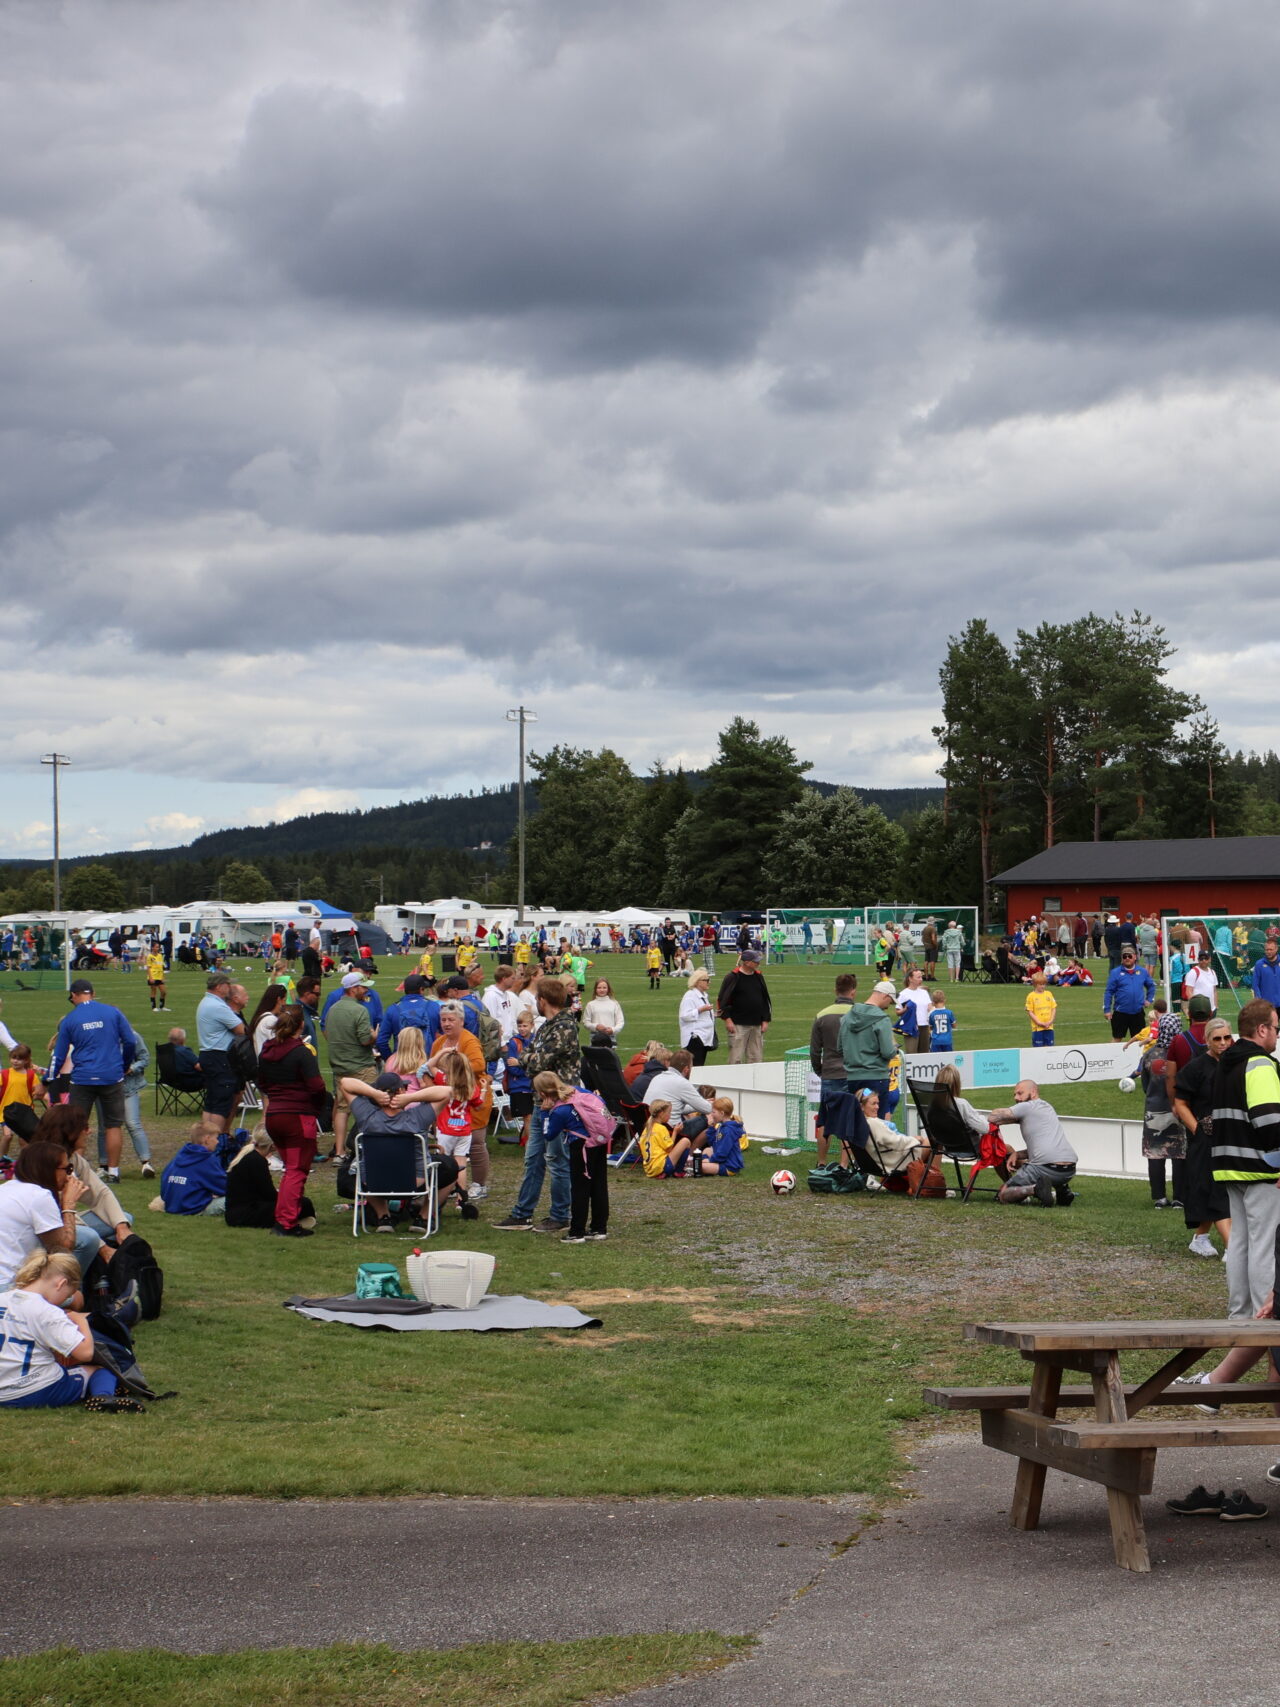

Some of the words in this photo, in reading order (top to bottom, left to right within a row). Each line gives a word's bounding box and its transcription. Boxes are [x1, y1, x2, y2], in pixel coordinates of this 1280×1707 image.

[1189, 945, 1196, 961] 4
[935, 1020, 948, 1034] 16
[1046, 1060, 1083, 1071] GLOBALL
[1087, 1059, 1115, 1068] SPORT
[645, 1141, 651, 1162] 3
